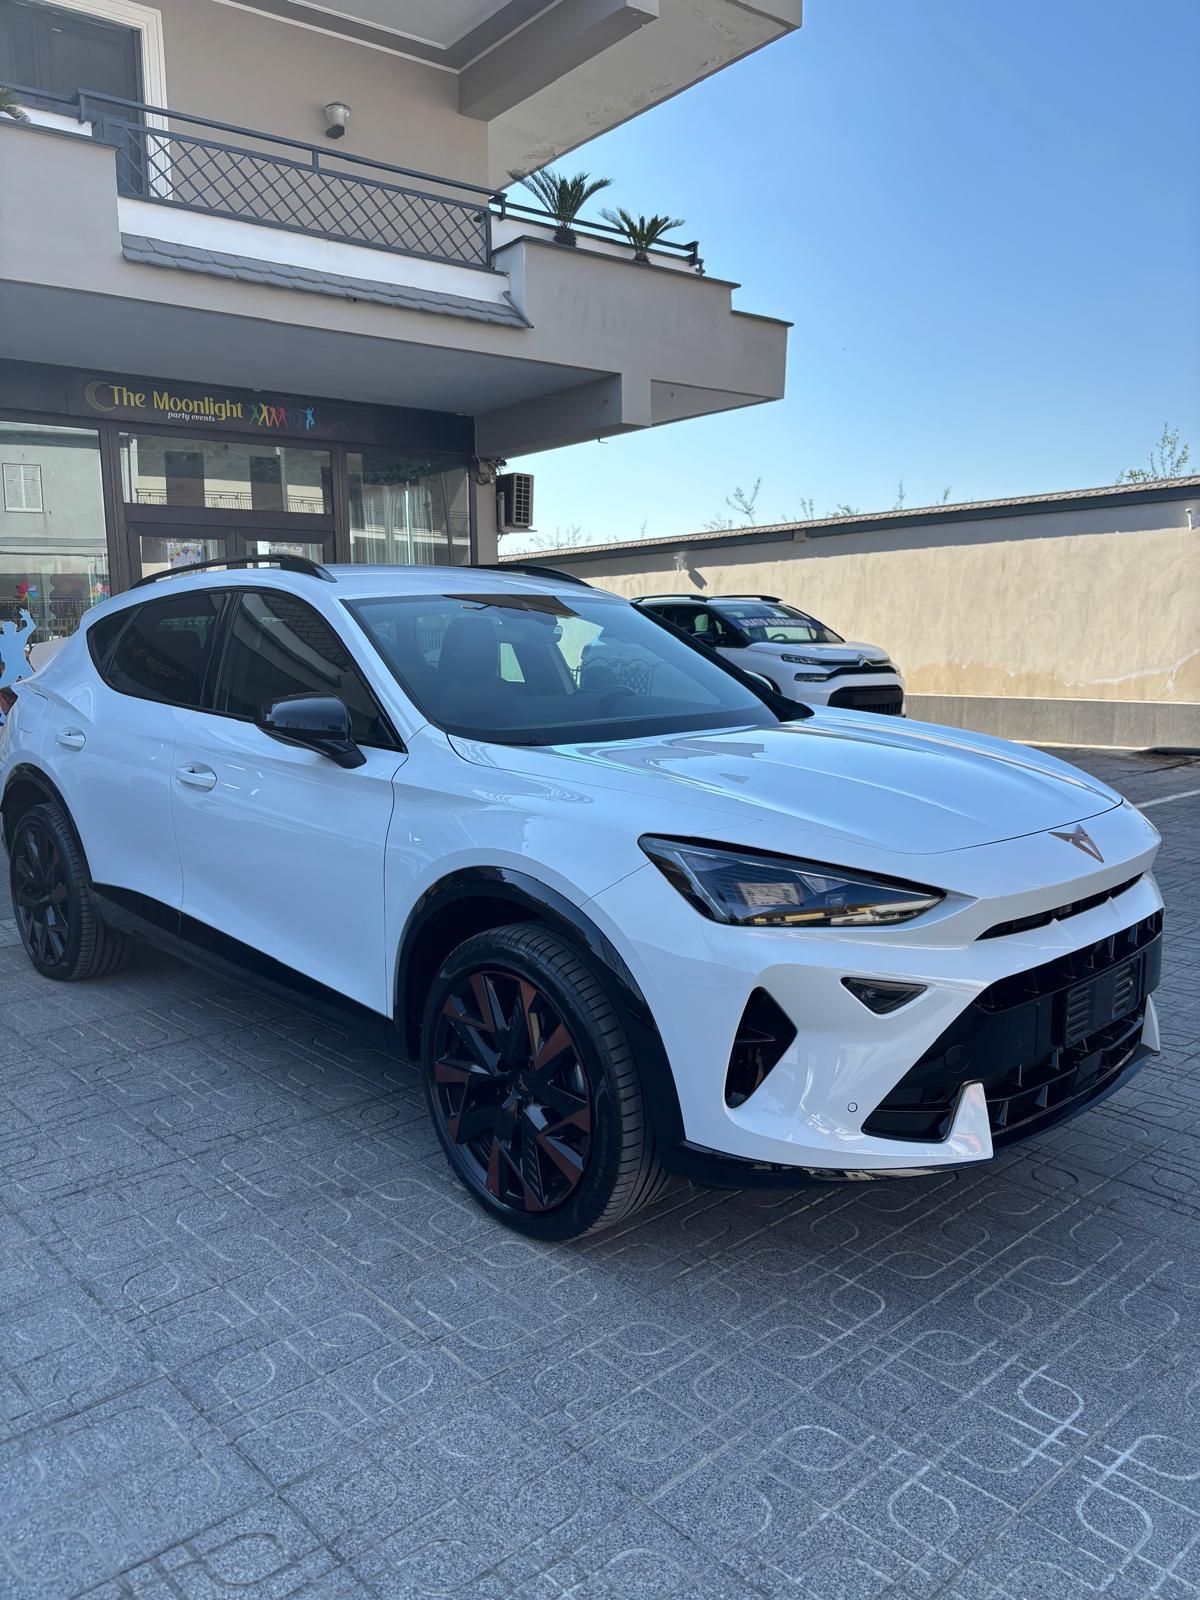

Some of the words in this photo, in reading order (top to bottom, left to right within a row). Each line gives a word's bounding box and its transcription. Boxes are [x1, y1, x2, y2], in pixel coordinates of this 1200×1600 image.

[109, 385, 146, 408] The
[153, 390, 243, 420] Moonlight
[168, 411, 190, 421] party
